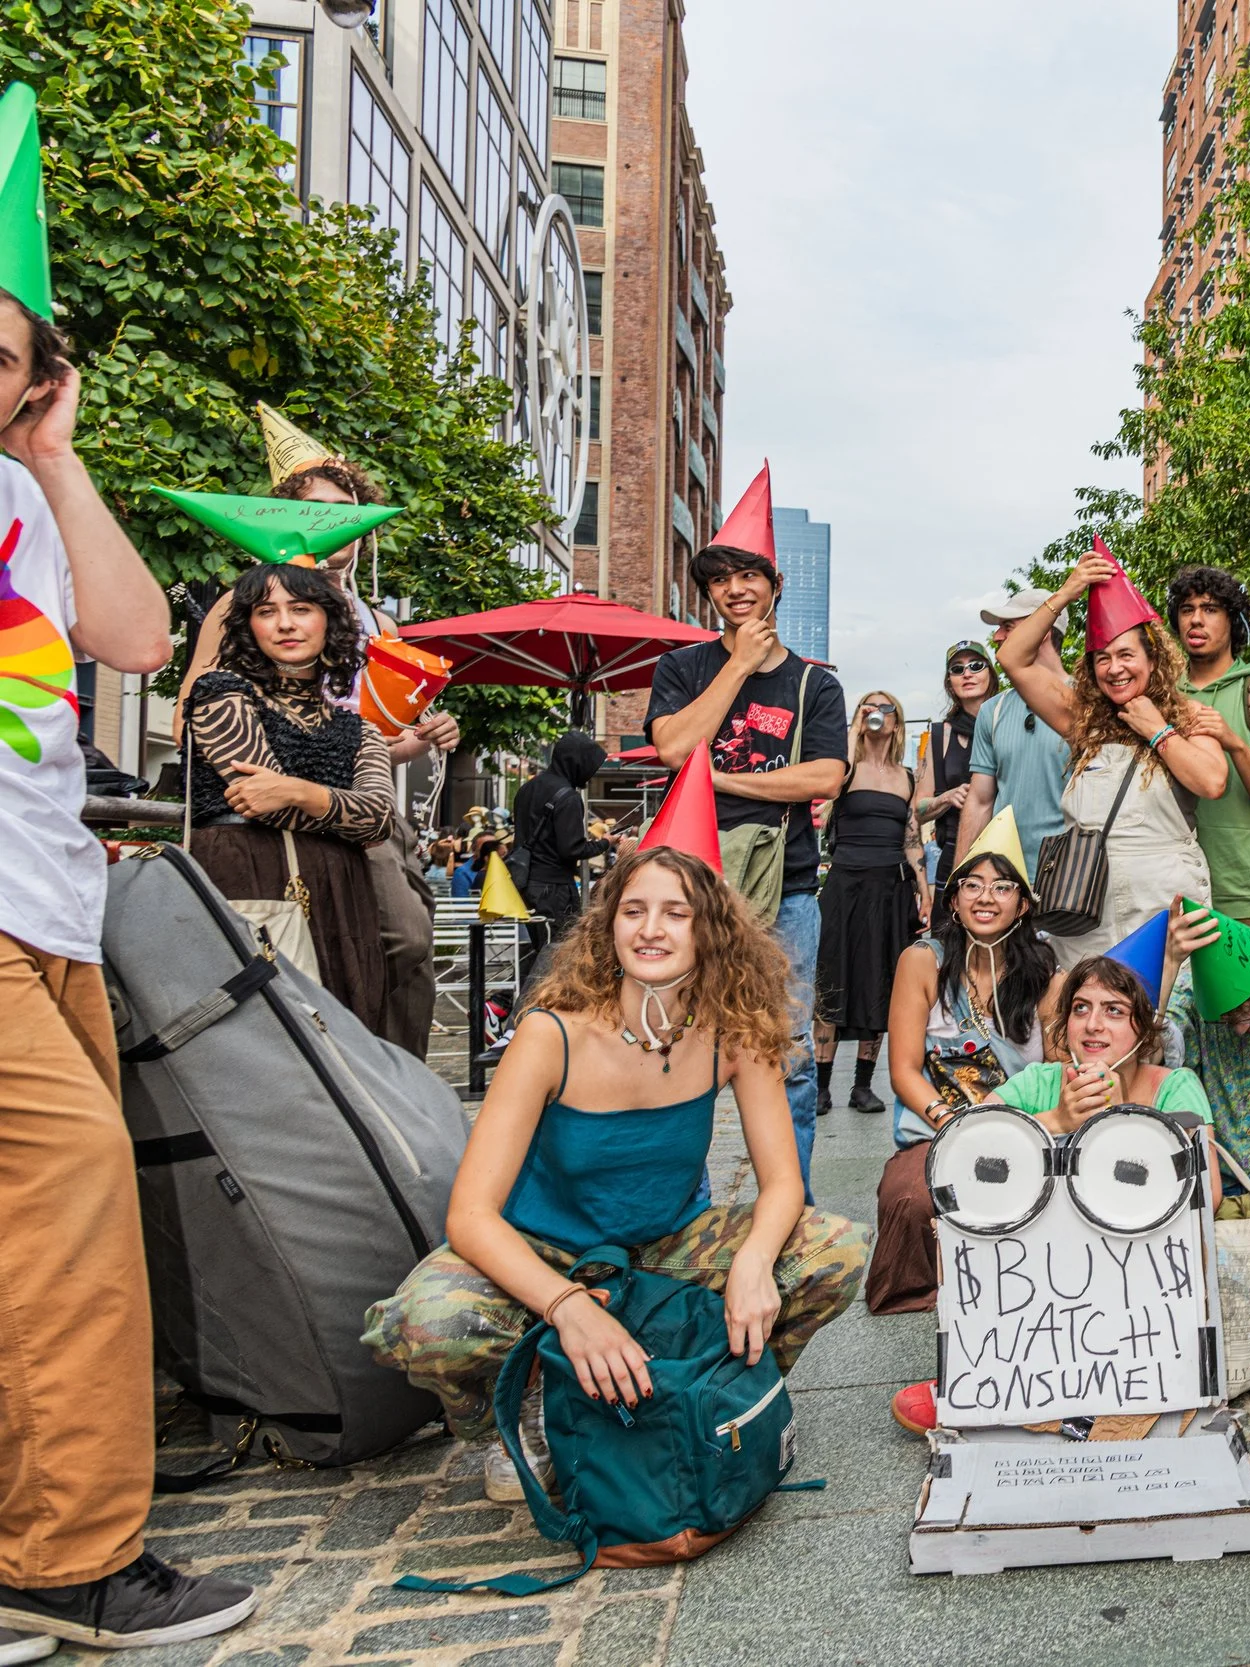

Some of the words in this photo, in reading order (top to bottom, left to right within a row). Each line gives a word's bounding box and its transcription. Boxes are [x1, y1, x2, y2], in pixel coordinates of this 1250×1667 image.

[255, 507, 287, 516] am
[751, 703, 762, 712] NO
[748, 710, 789, 731] BORDERS
[759, 723, 781, 736] BOOKS
[954, 1302, 1181, 1367] WATCH!
[948, 1361, 1168, 1411] CONSUME!
